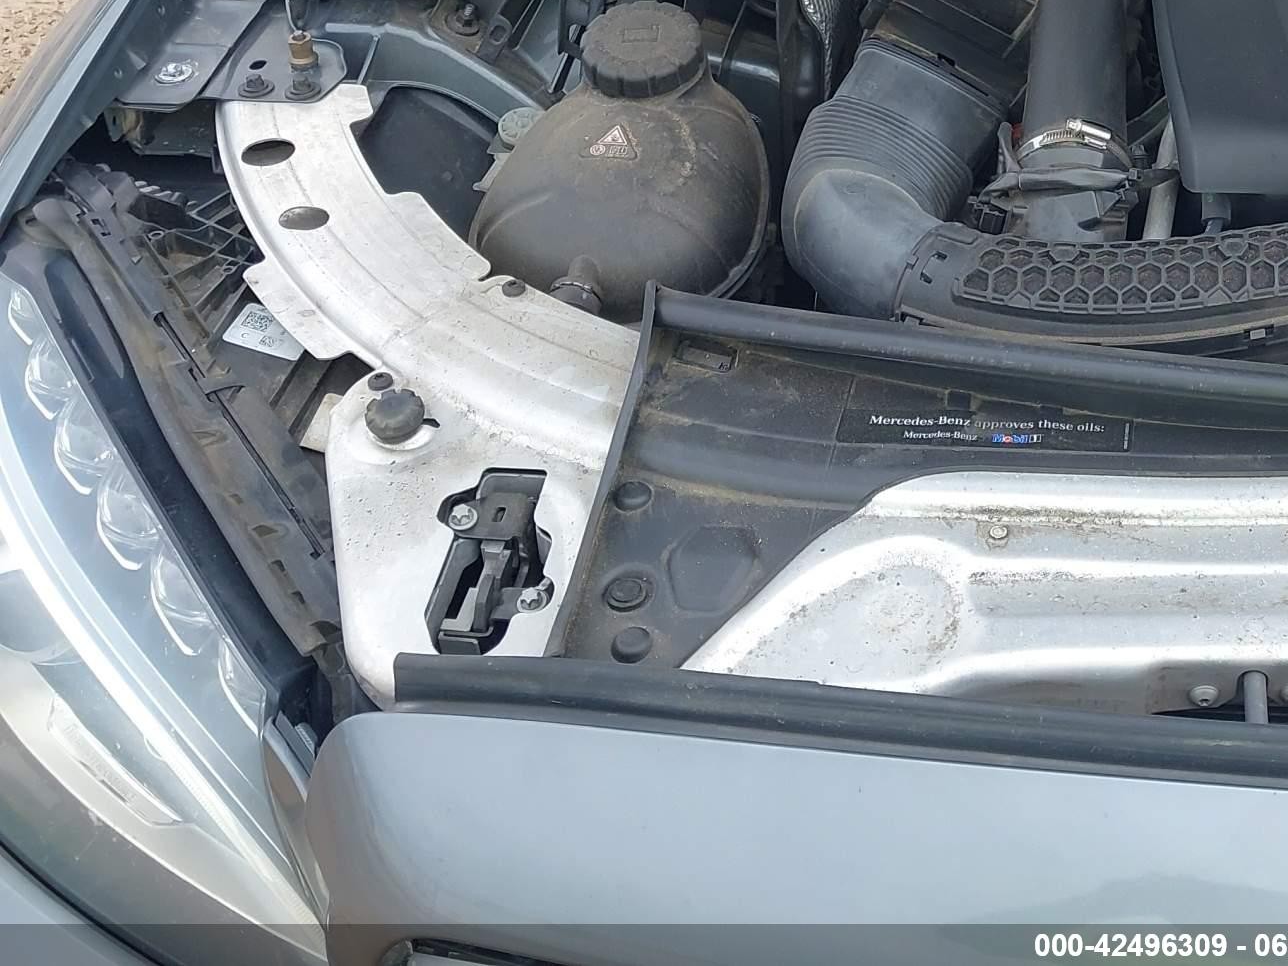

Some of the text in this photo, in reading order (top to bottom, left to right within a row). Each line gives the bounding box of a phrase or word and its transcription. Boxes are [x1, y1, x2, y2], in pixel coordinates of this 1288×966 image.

[869, 415, 1105, 433] Mercedes-Benz approves these oils:
[903, 430, 978, 441] Mercedes-Benz
[992, 433, 1028, 443] Mobil
